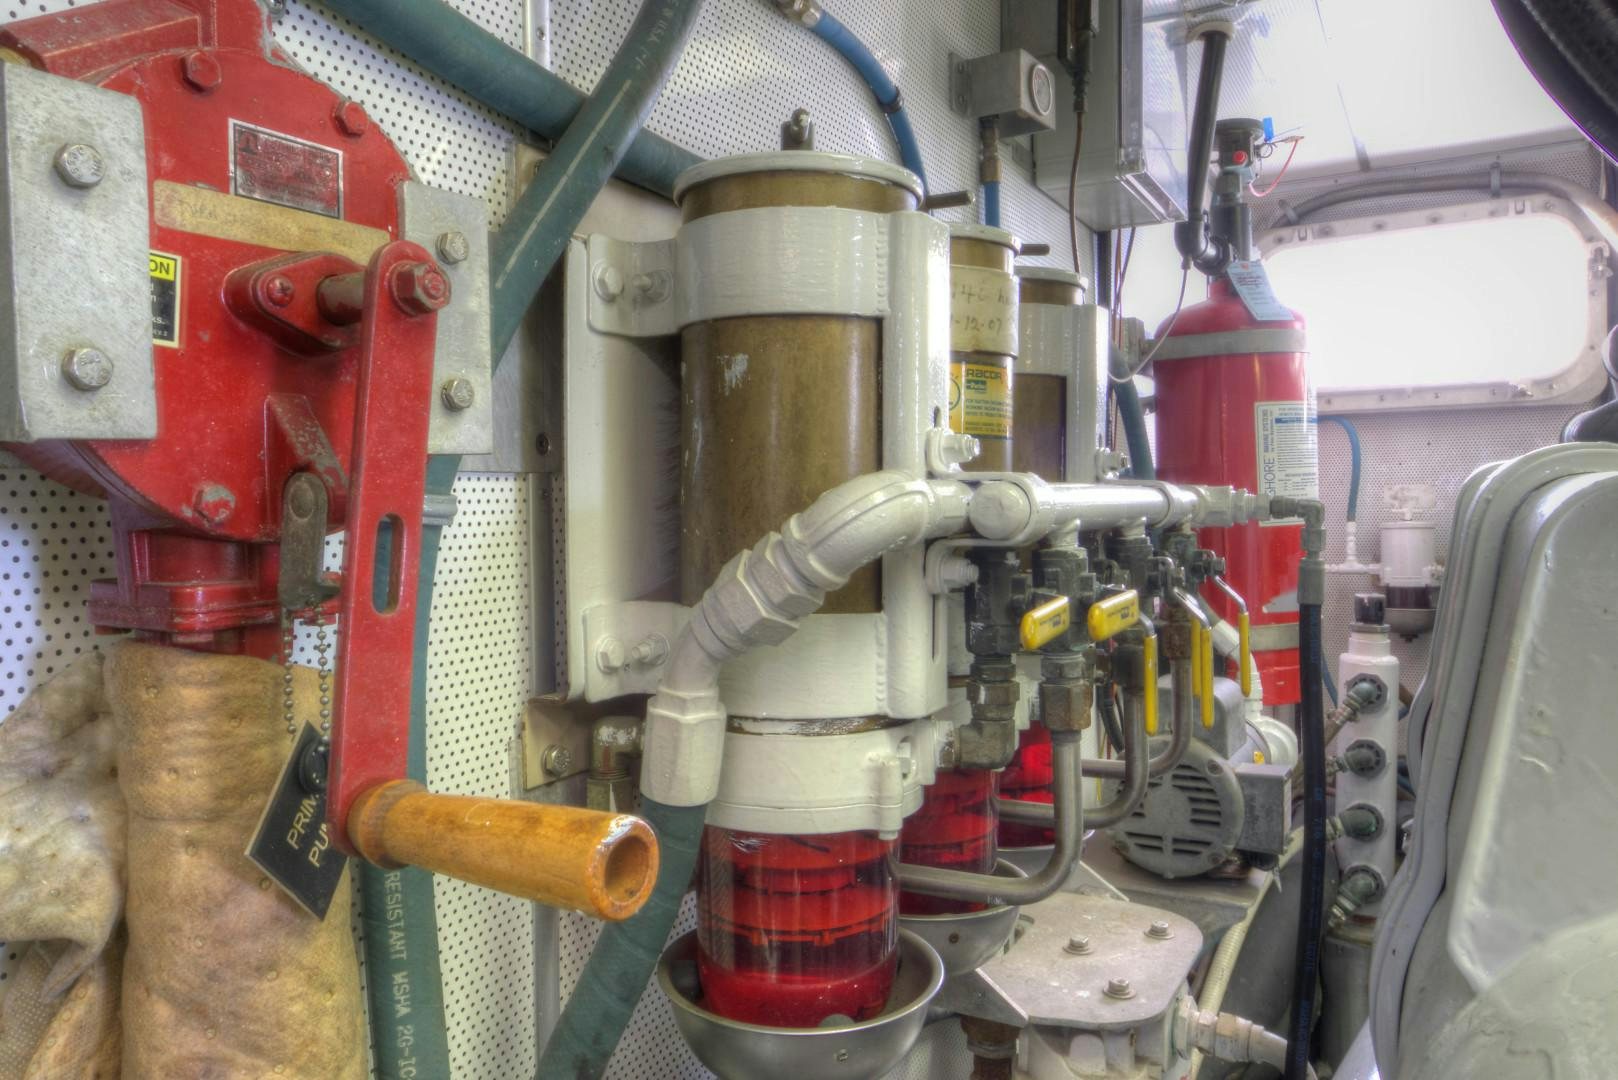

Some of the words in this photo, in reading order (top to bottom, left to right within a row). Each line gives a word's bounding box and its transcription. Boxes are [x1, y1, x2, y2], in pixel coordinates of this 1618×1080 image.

[384, 871, 407, 960] RESISTANT
[392, 971, 412, 1018] MSHA
[397, 1024, 417, 1080] 2G-IC
